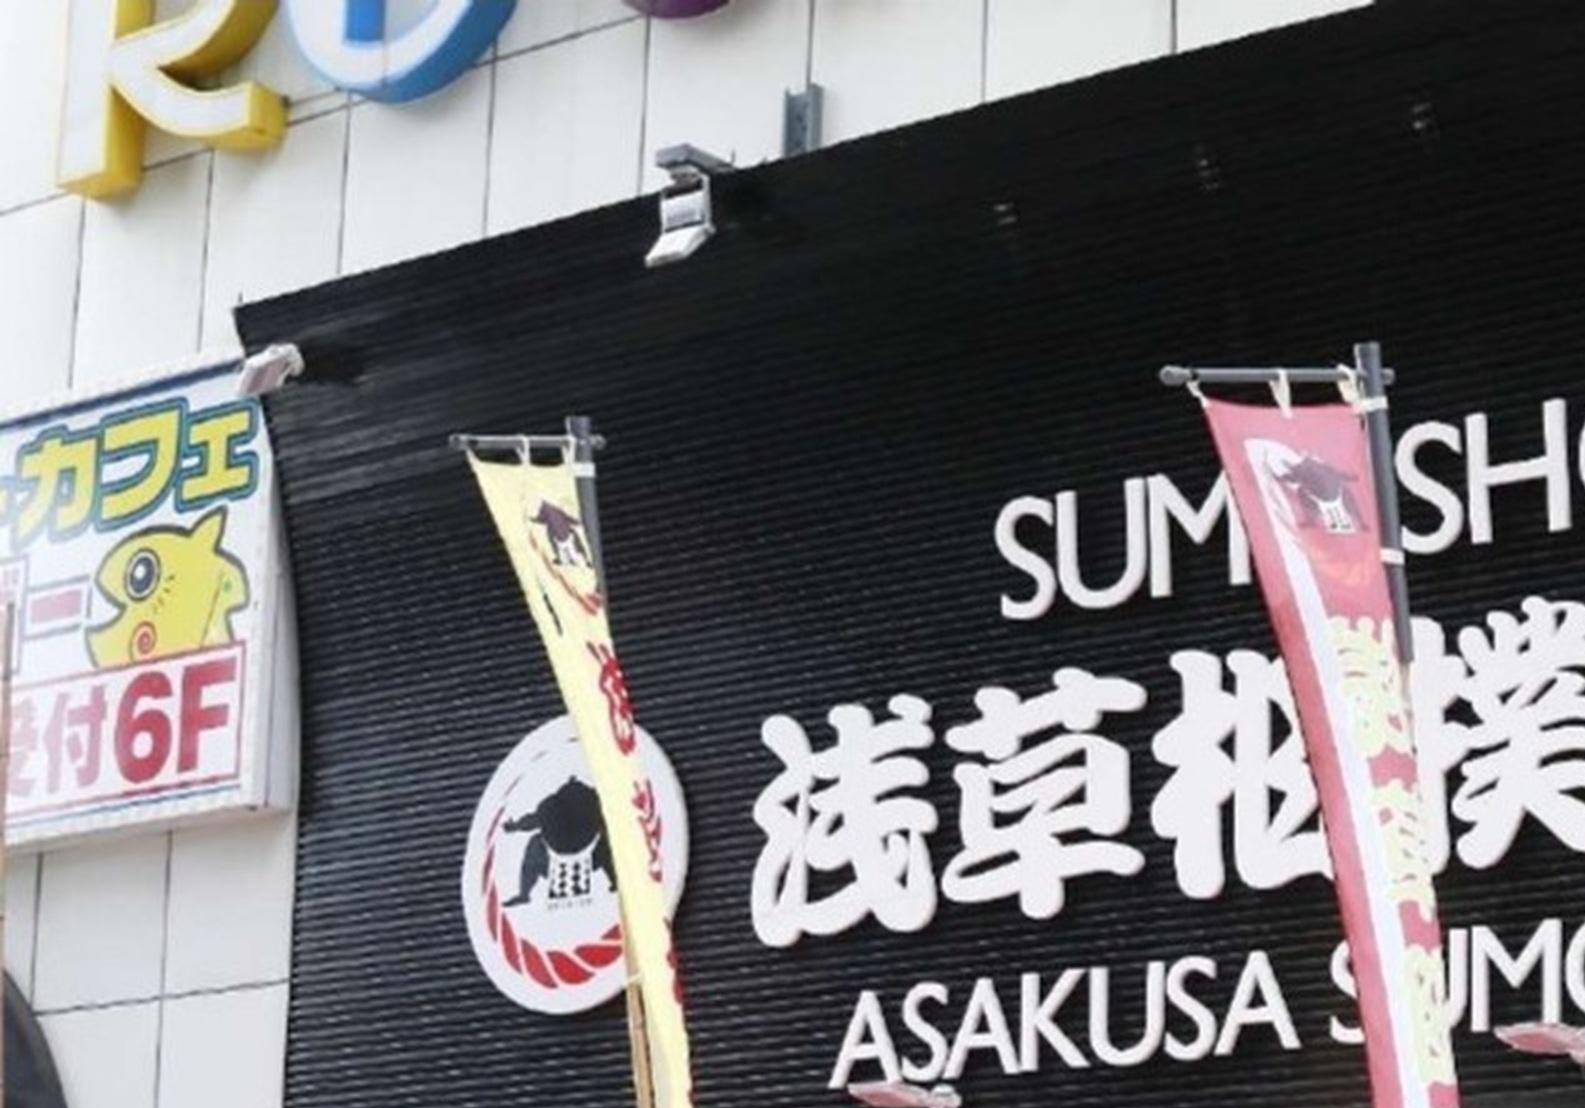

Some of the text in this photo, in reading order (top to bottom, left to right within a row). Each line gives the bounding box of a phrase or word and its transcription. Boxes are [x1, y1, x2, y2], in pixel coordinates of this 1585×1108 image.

[0, 397, 261, 552] カフェ
[995, 475, 1252, 618] SUM
[828, 950, 1300, 1090] ASAKUSA
